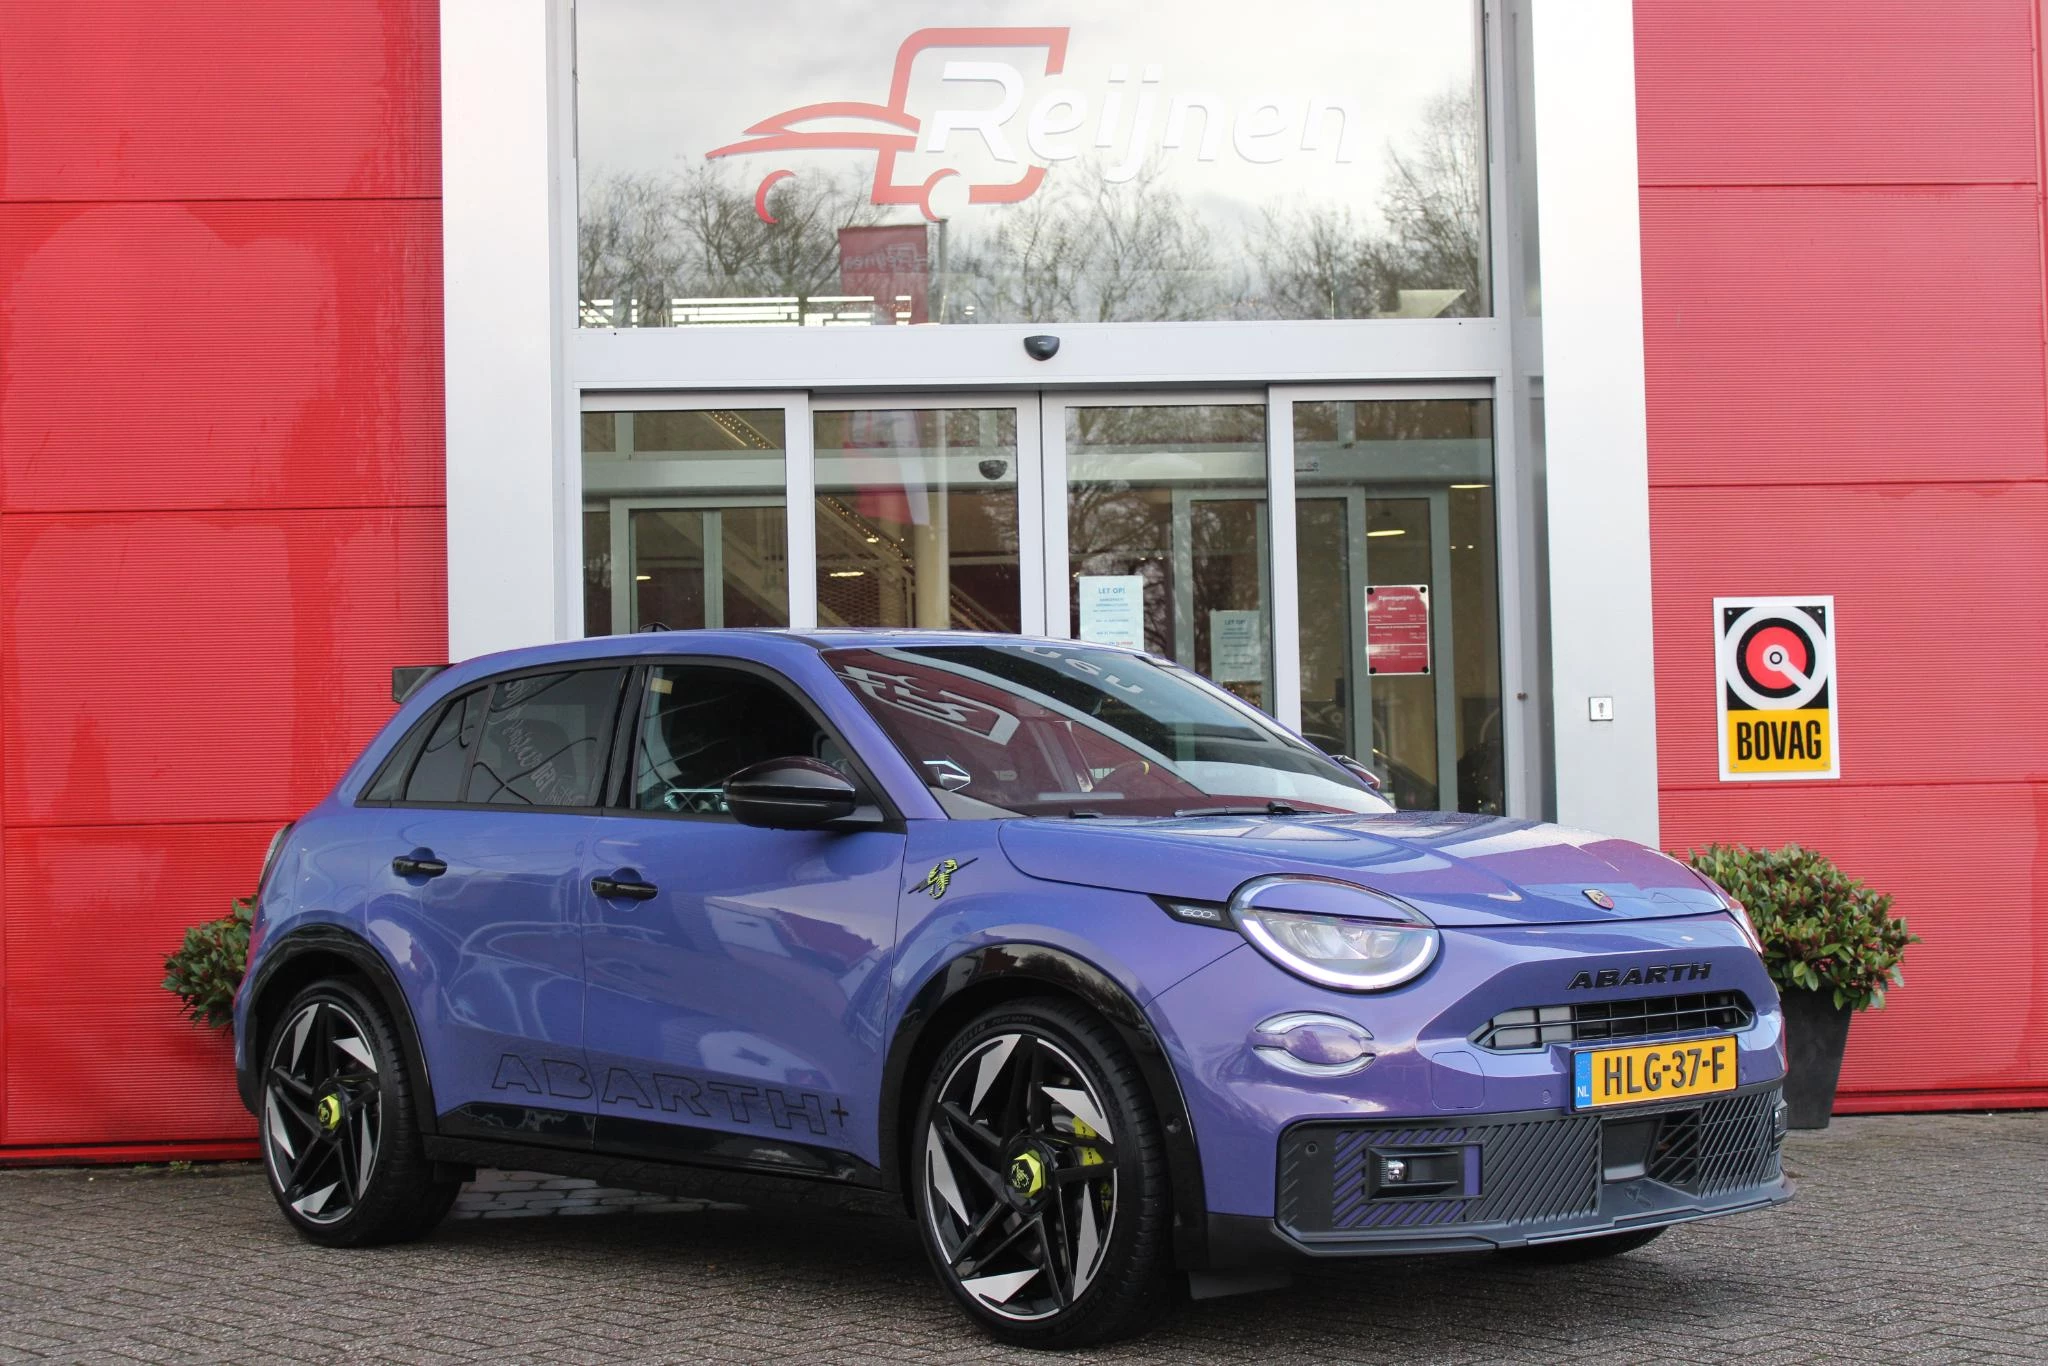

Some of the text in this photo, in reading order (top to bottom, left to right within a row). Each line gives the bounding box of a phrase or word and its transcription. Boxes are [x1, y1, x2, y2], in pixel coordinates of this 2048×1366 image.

[925, 61, 1359, 184] Reijnen
[1737, 720, 1821, 760] BOVAG
[1567, 962, 1713, 990] ABARTH
[1604, 1046, 1725, 1096] HLG-37-F
[1577, 1087, 1589, 1097] NL
